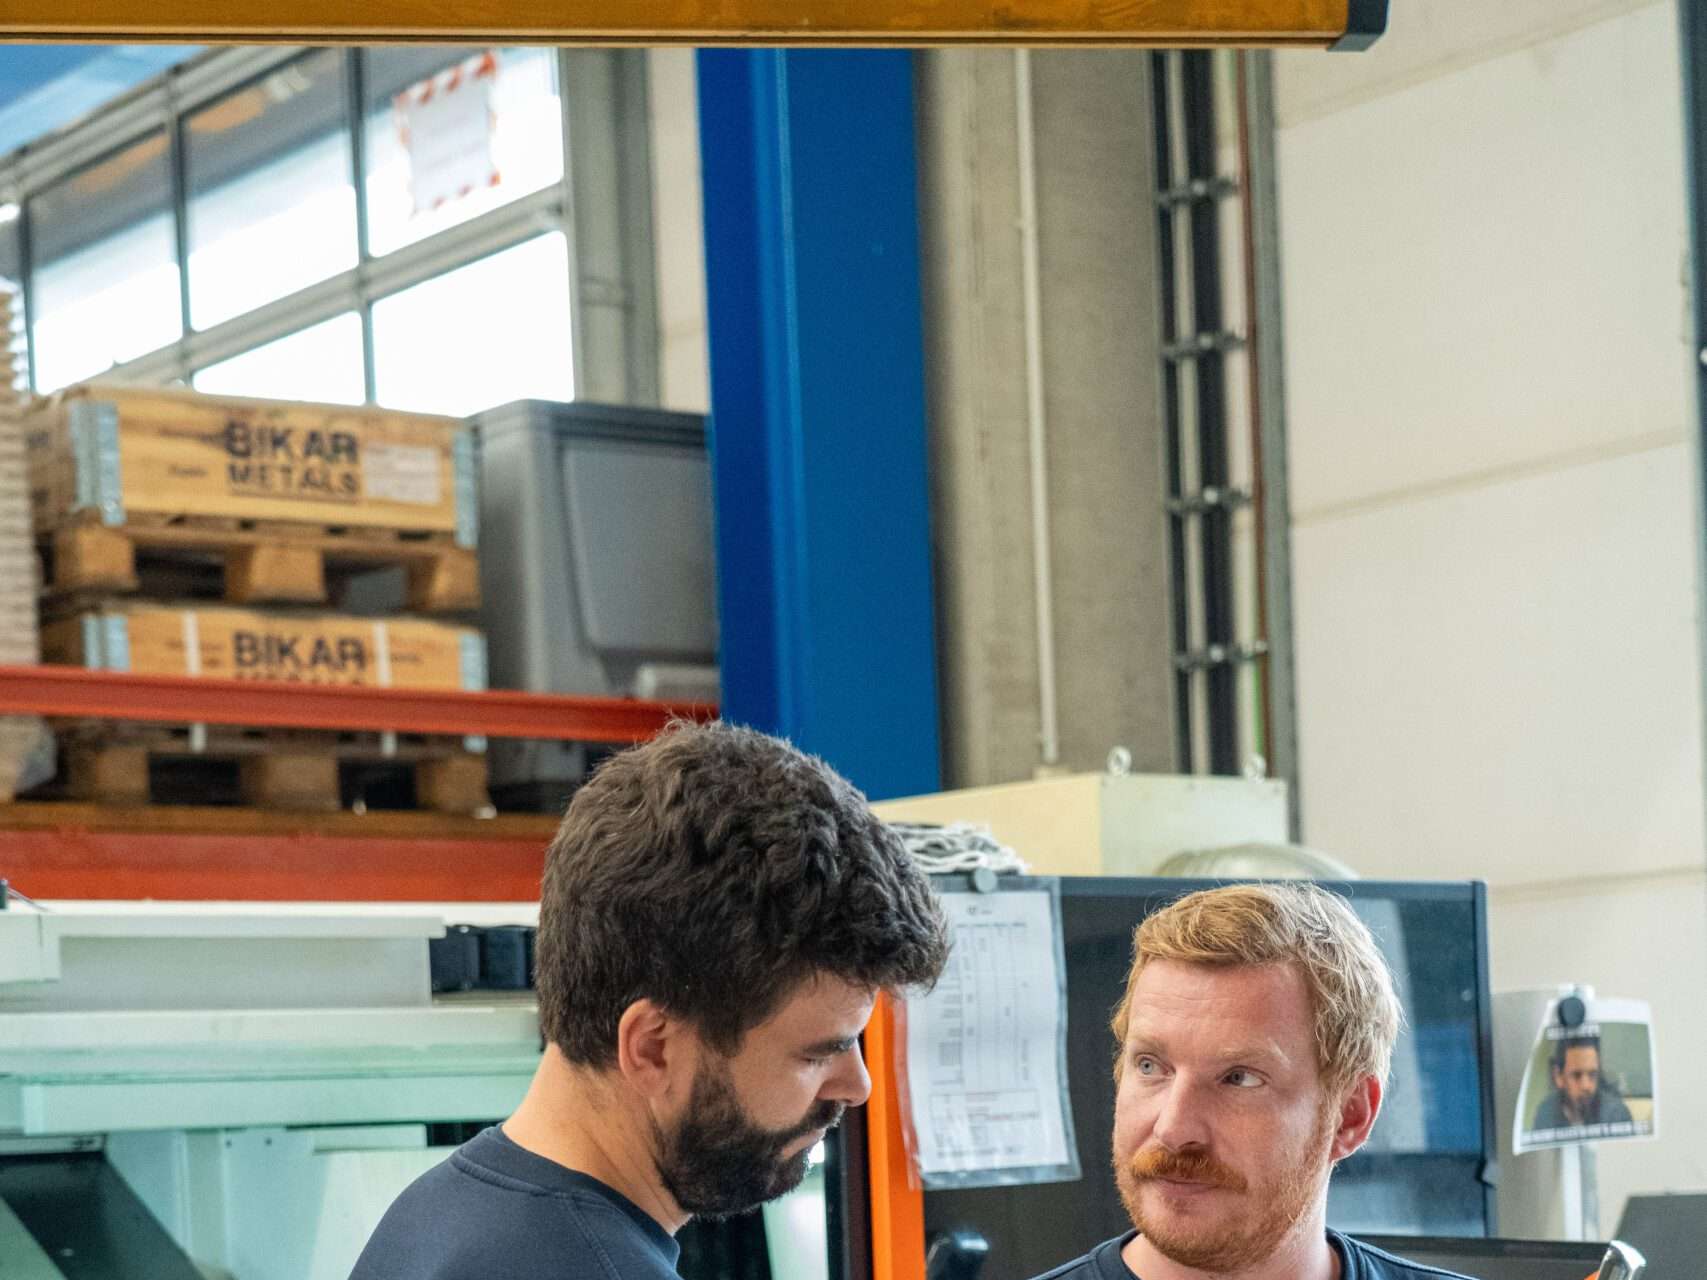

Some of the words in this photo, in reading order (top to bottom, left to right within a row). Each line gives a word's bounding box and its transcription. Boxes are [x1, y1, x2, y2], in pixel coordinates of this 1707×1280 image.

[225, 419, 359, 465] BIKAR
[228, 464, 360, 496] METALS
[233, 630, 366, 671] BIKAR
